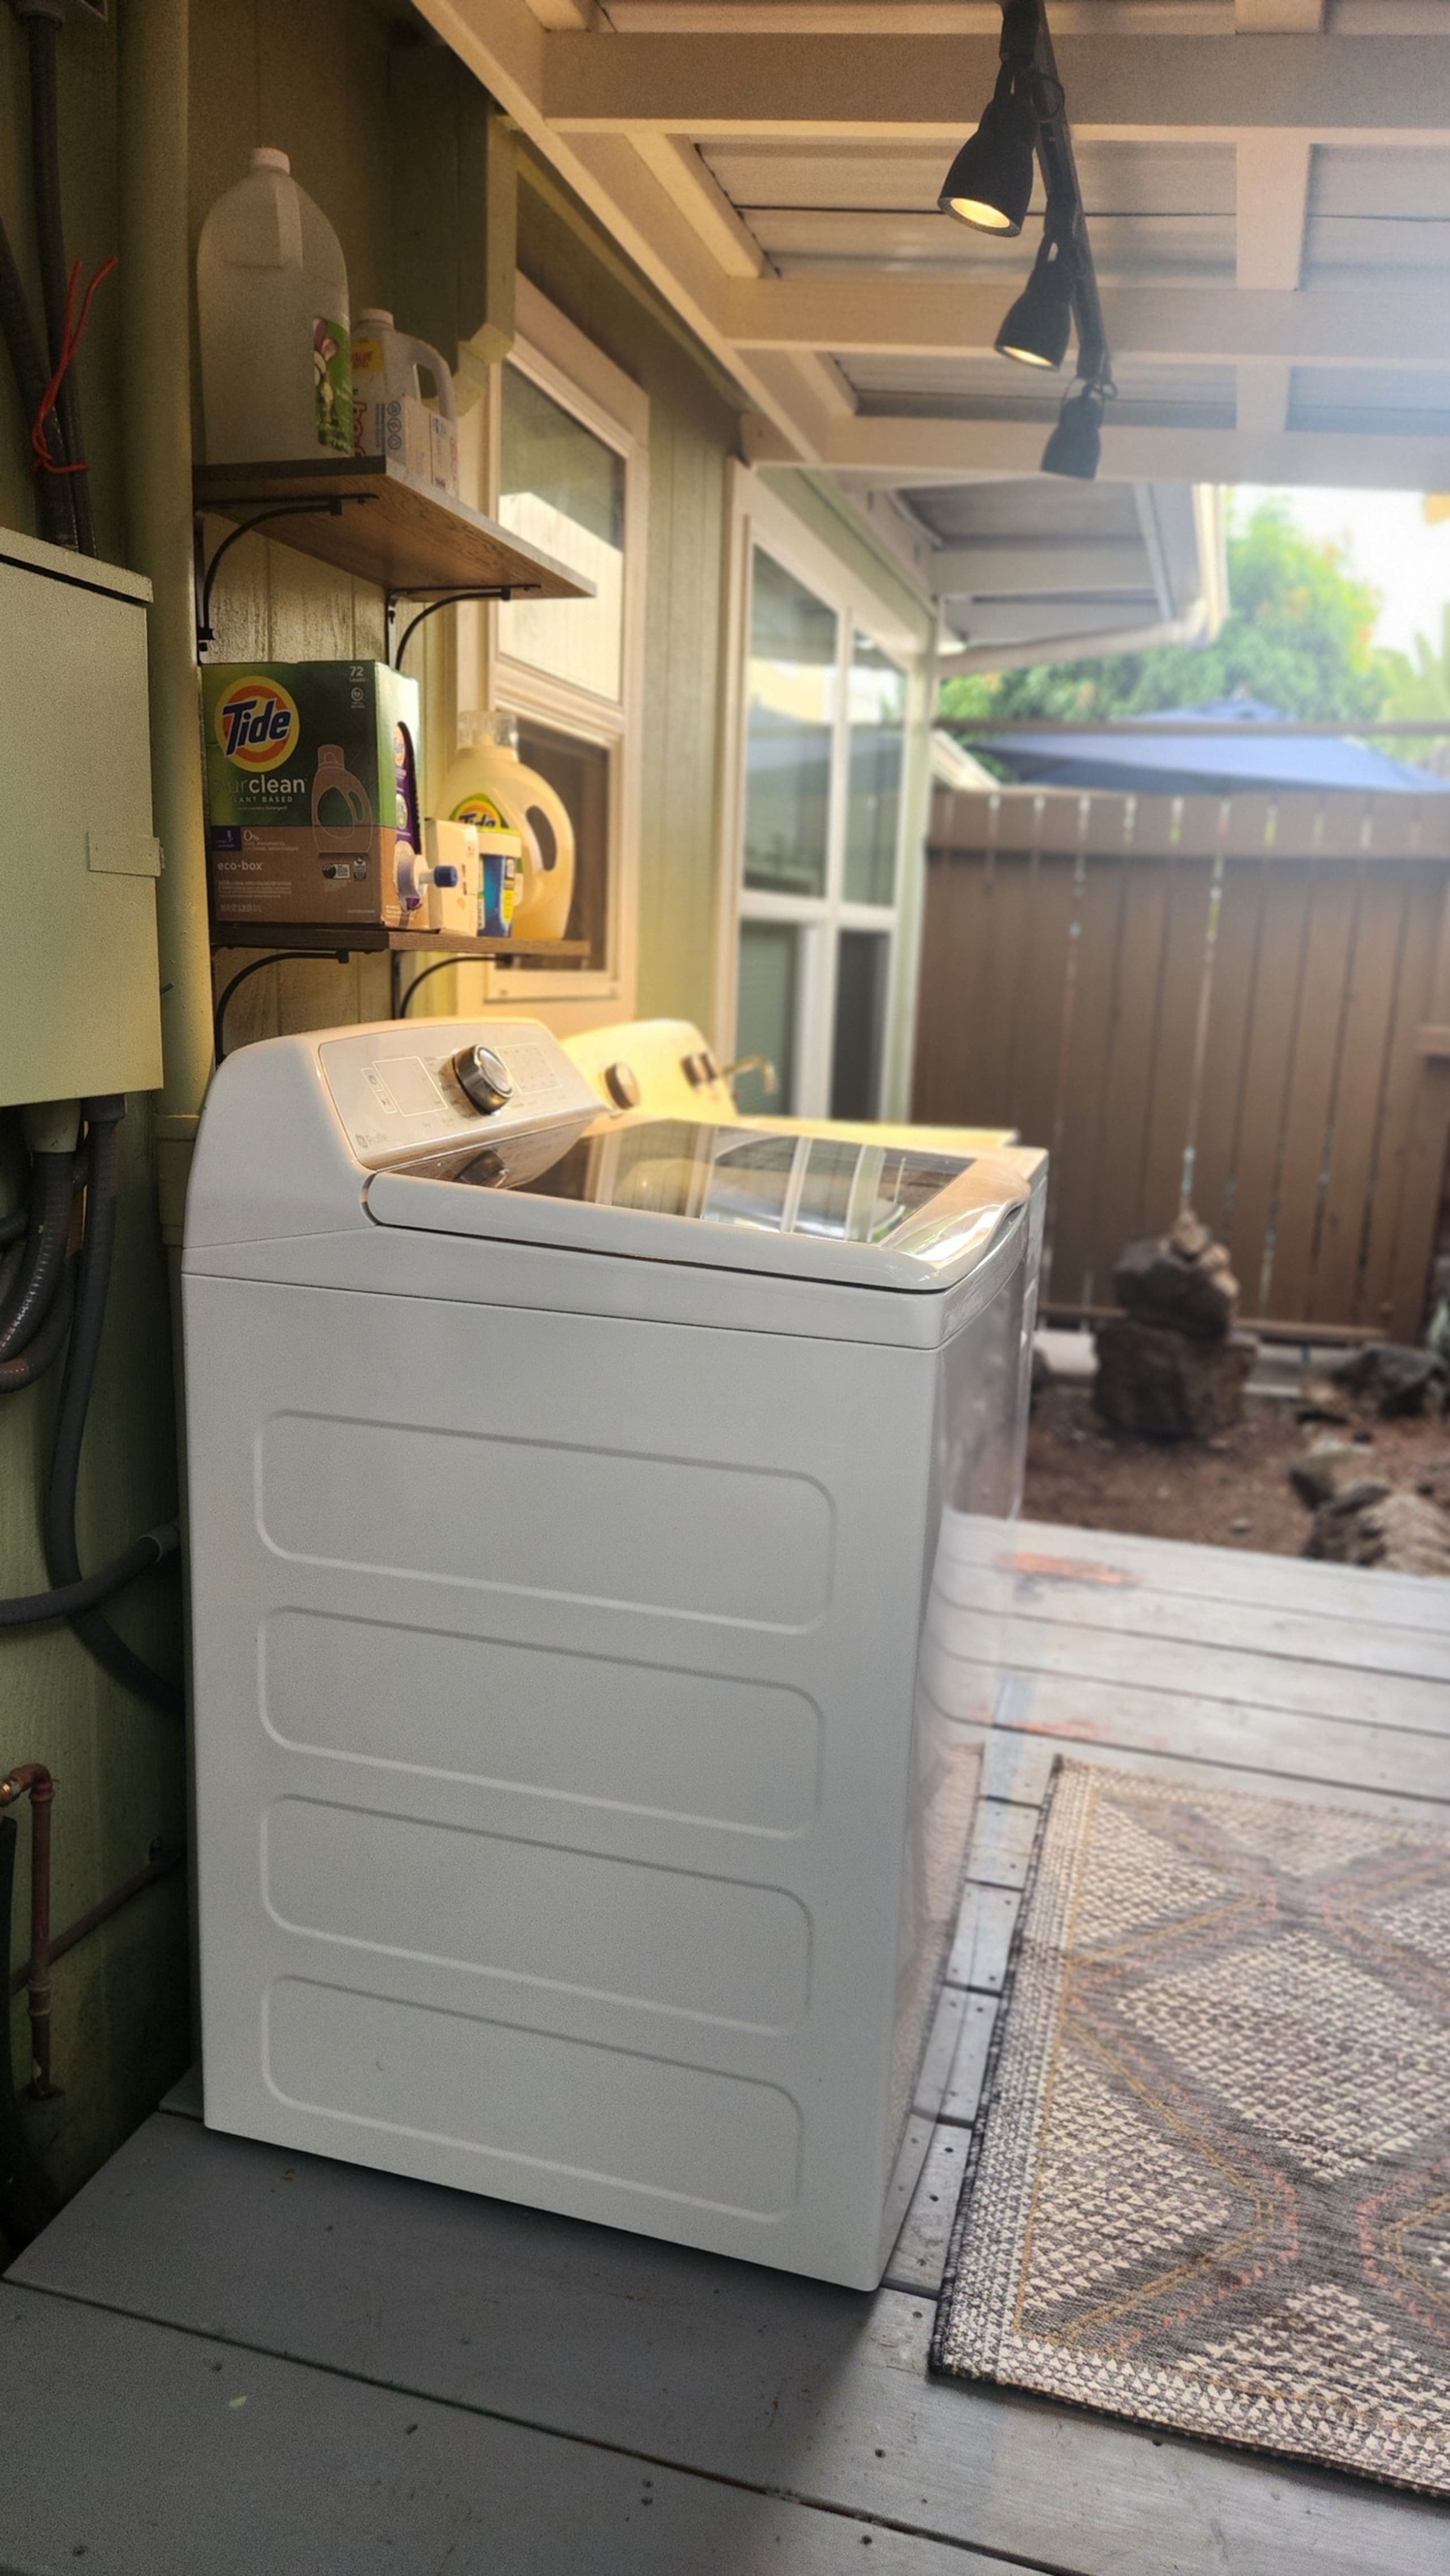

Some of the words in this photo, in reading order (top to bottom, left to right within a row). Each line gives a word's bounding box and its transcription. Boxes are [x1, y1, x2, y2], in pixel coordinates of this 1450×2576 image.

[349, 666, 364, 676] 72
[222, 700, 292, 756] Tide
[218, 860, 262, 871] eco-box
